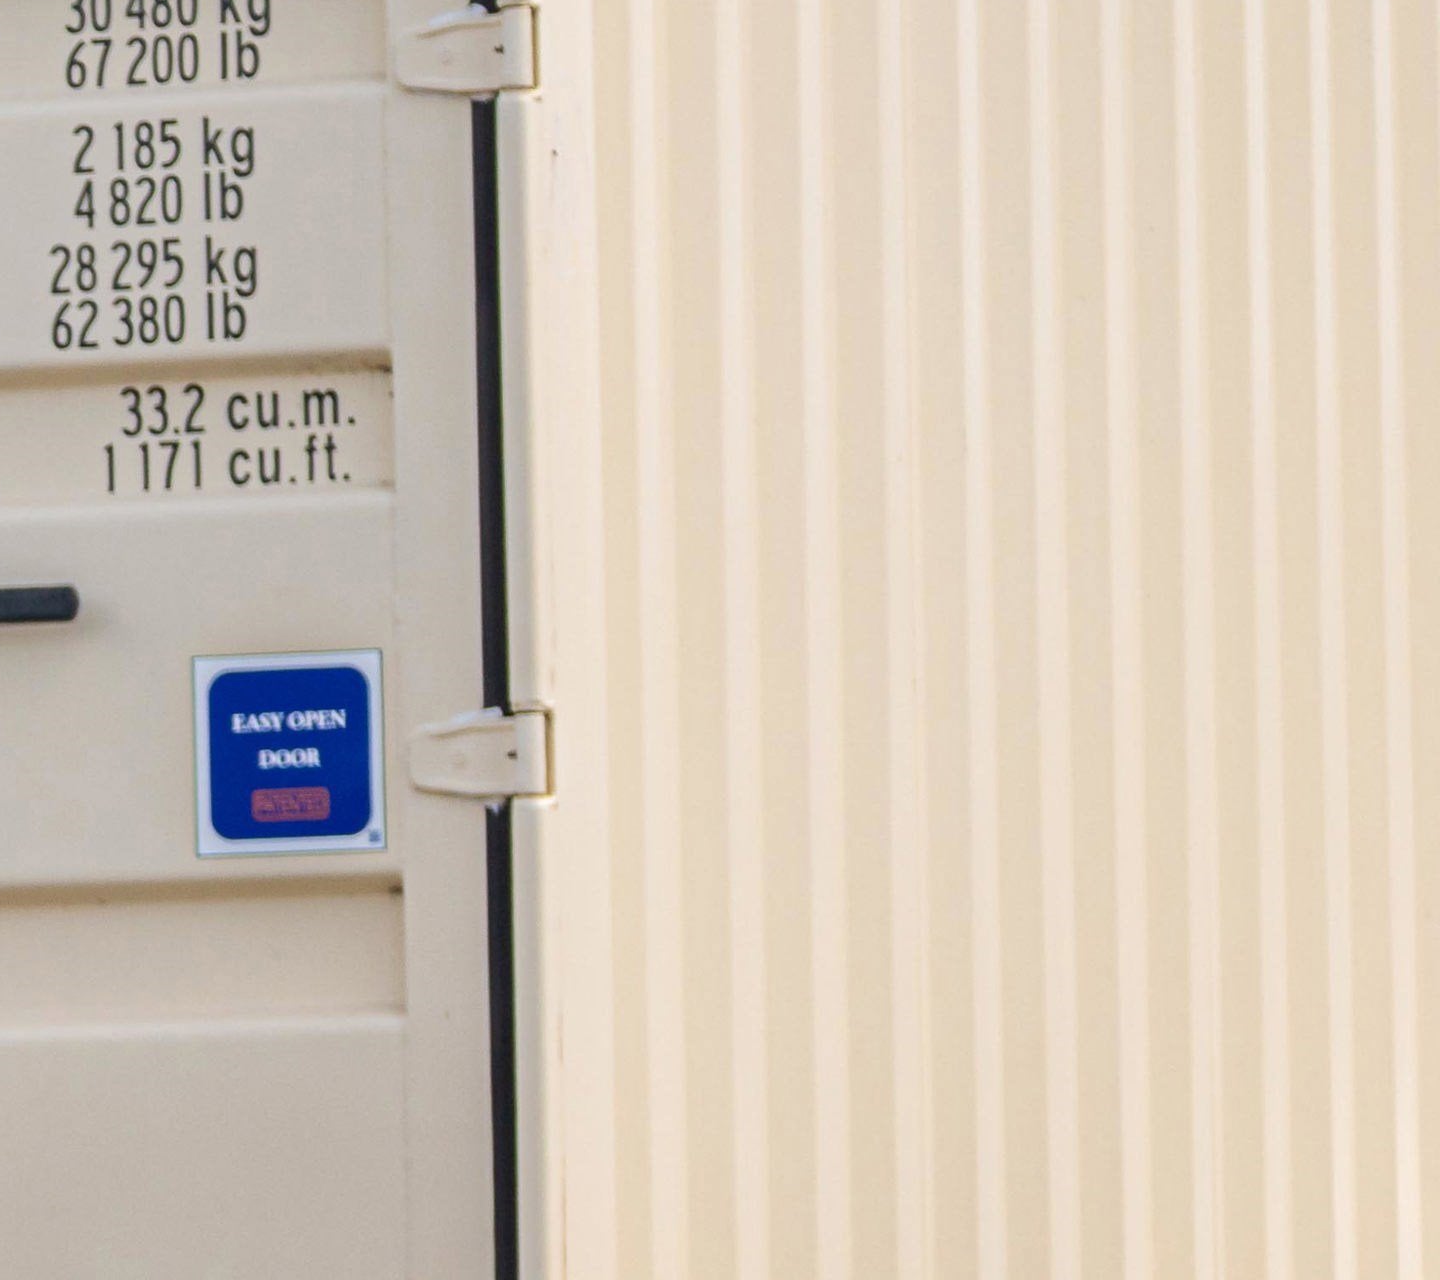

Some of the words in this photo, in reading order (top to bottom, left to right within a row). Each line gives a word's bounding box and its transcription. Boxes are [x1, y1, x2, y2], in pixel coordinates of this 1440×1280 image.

[219, 29, 261, 81] lb
[201, 116, 256, 179] kg
[203, 170, 245, 222] lb
[204, 235, 258, 299] kg
[205, 290, 248, 341] lb
[119, 381, 206, 438] 33.2
[225, 388, 357, 432] cu.m.
[227, 433, 351, 487] cu.ft.
[230, 711, 285, 733] EASY
[285, 708, 347, 731] OPEN
[257, 747, 321, 770] DOOR
